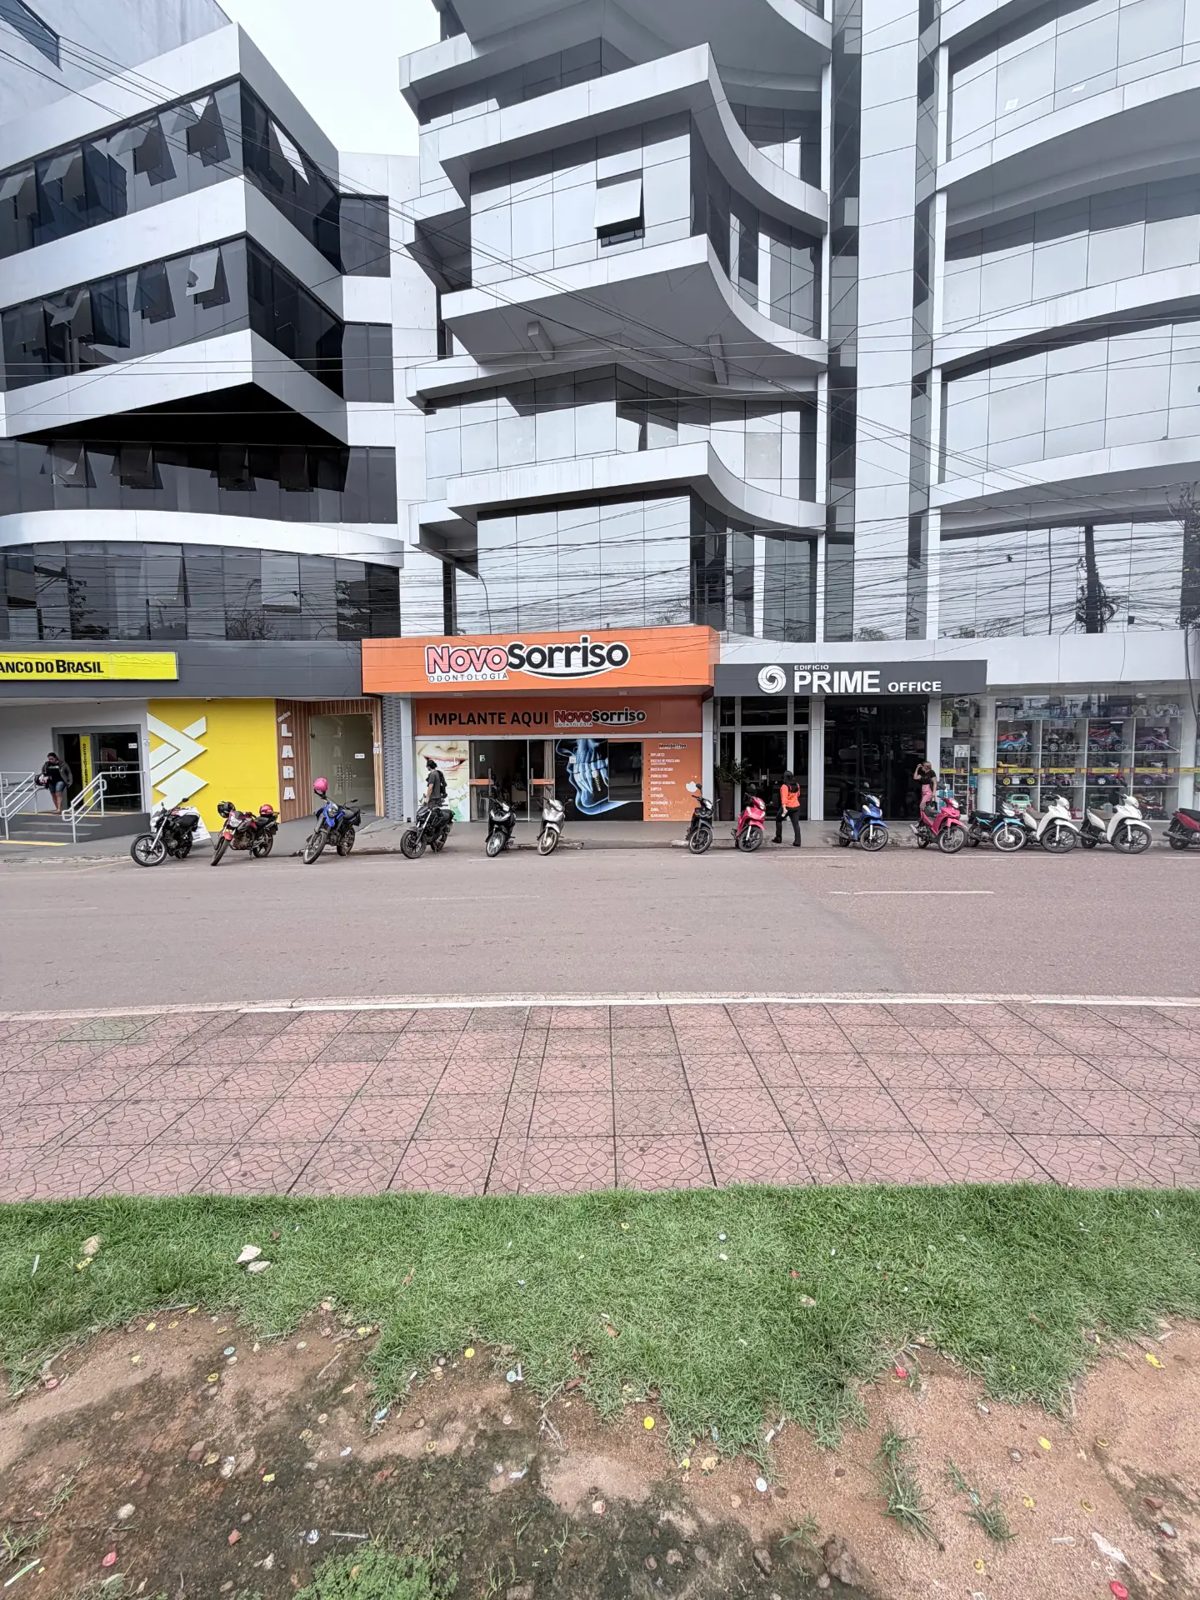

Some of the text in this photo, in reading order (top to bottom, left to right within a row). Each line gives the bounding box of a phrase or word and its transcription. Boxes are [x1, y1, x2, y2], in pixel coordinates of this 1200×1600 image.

[35, 661, 54, 673] DO
[55, 659, 104, 673] BRASIL
[428, 672, 509, 683] ODONTOLOGIA
[793, 670, 941, 693] PRIME OFFICE
[428, 711, 549, 727] IMPLANTE AQUI
[281, 723, 296, 800] LARA
